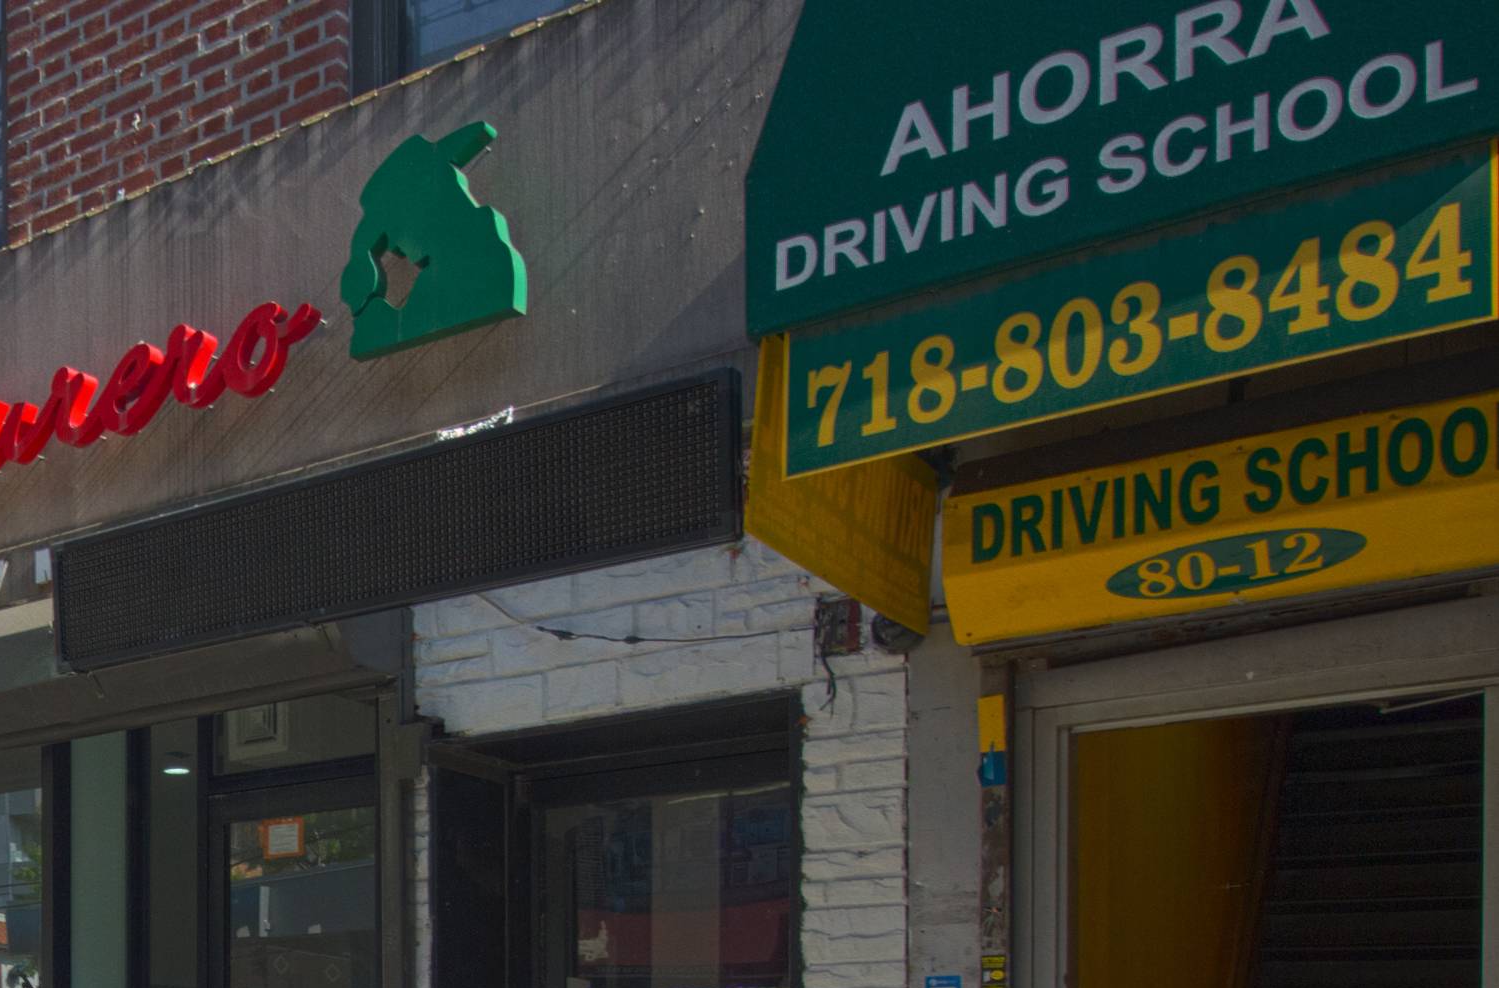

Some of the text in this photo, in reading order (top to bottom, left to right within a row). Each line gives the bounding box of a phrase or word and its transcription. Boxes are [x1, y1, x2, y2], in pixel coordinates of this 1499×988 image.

[774, 40, 1479, 291] DRIVING SCHOOL
[880, 0, 1331, 176] AHORRA
[806, 203, 1473, 448] 718-803-8484
[971, 406, 1499, 565] DRIVING SCHOO
[1135, 531, 1324, 597] 80-12
